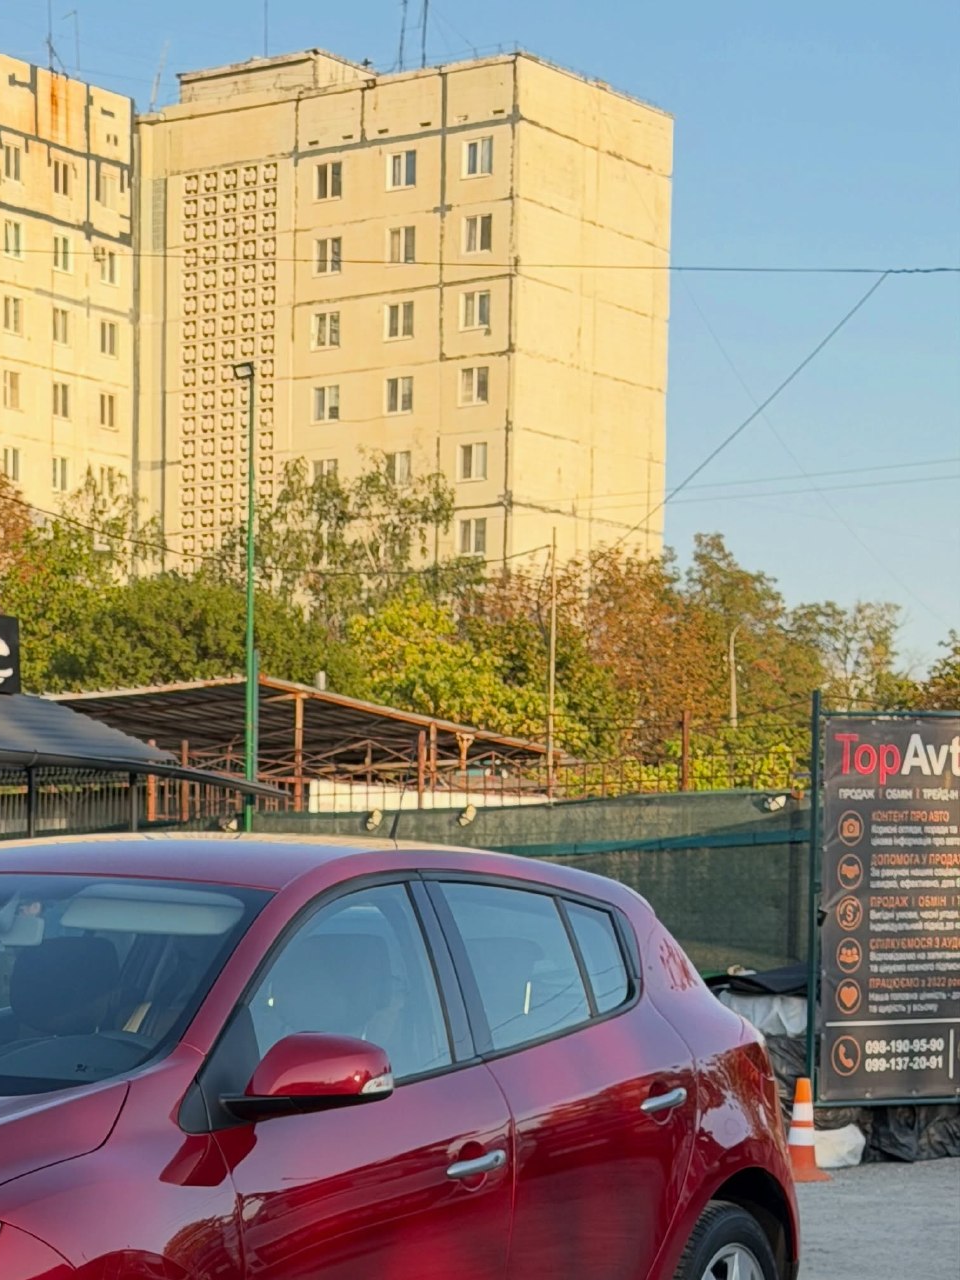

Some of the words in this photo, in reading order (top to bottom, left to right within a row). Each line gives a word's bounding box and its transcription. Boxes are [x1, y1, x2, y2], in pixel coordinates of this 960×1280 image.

[928, 810, 950, 822] АВТО
[865, 1038, 944, 1055] 098-190-95-90
[865, 1055, 943, 1072] 099-137-20-91
